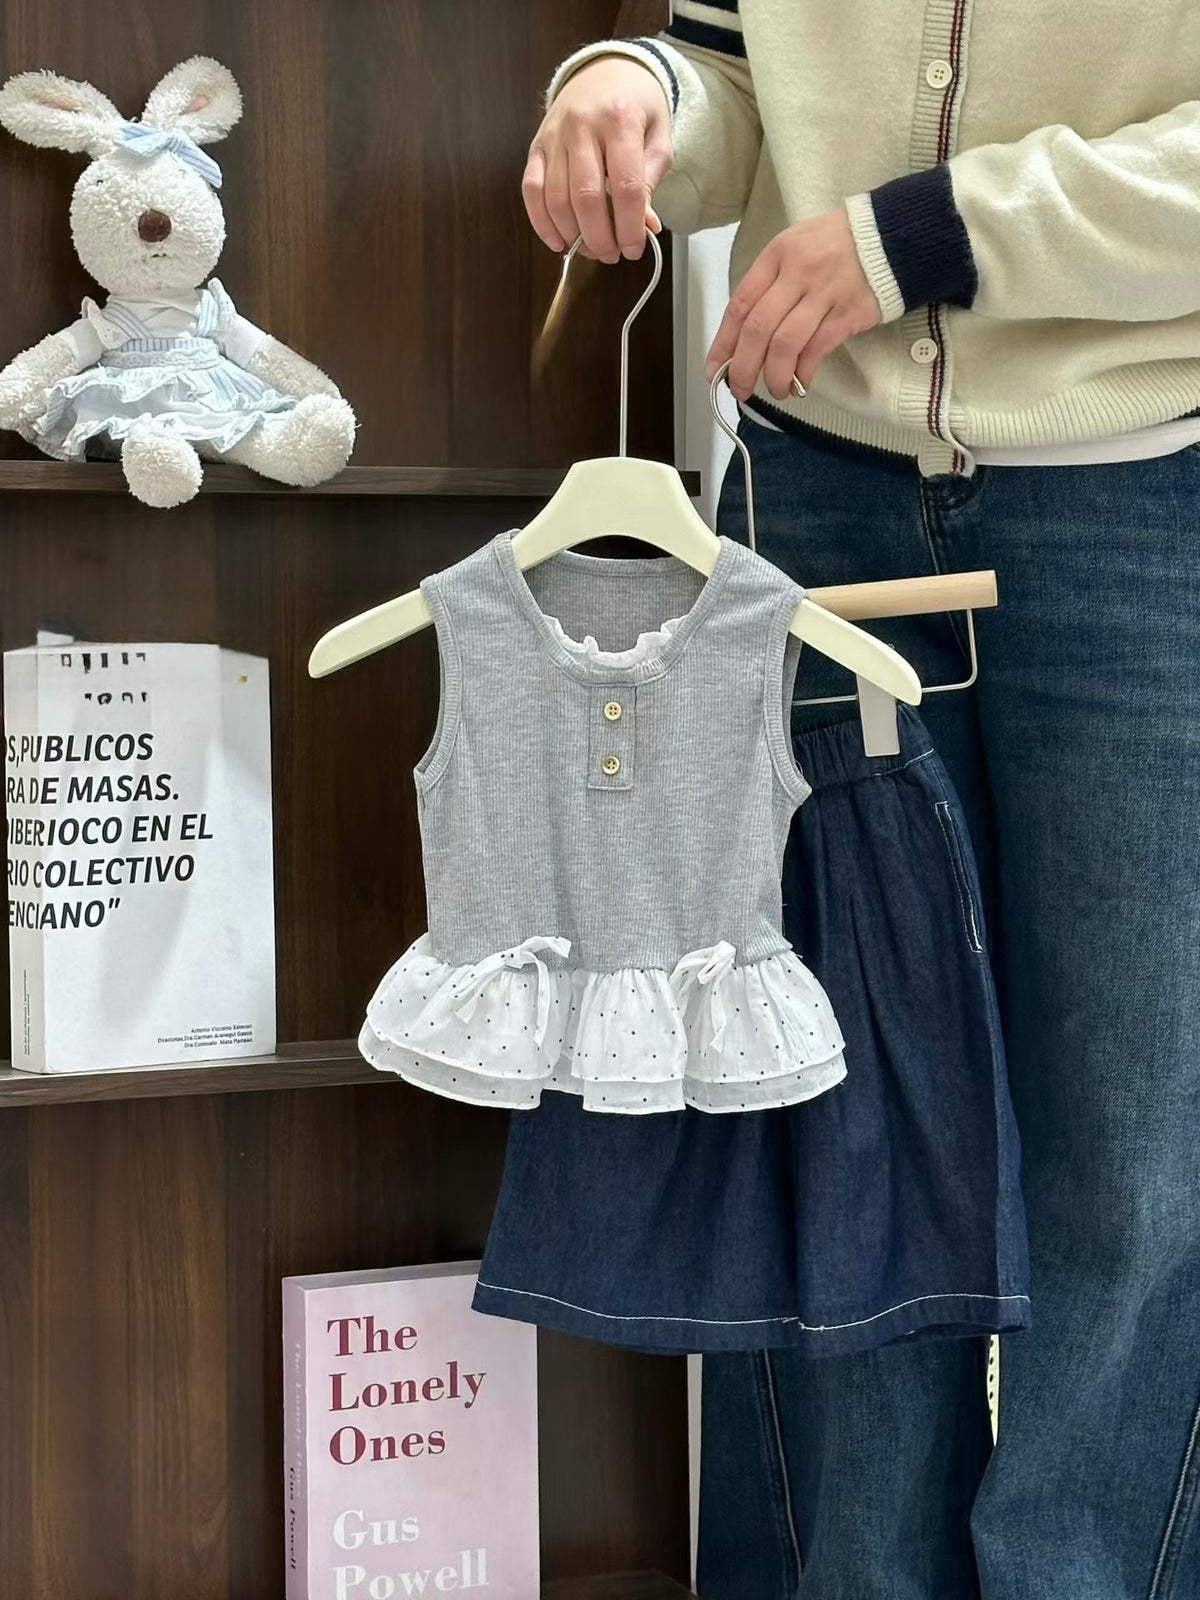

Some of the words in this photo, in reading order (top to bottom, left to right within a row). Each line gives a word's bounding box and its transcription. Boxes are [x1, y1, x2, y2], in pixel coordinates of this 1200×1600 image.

[5, 733, 154, 768] S,PUBLICOS
[30, 777, 60, 804] DE
[67, 774, 180, 804] MASAS.
[6, 817, 122, 847] IBERIOCO
[131, 815, 171, 843] EN
[180, 814, 214, 840] EL
[33, 854, 195, 888] COLECTIVO
[327, 1315, 418, 1357] The
[328, 1361, 487, 1411] Lonely
[329, 1425, 446, 1465] Ones
[333, 1509, 420, 1550] Gus
[331, 1547, 489, 1600] Powell
